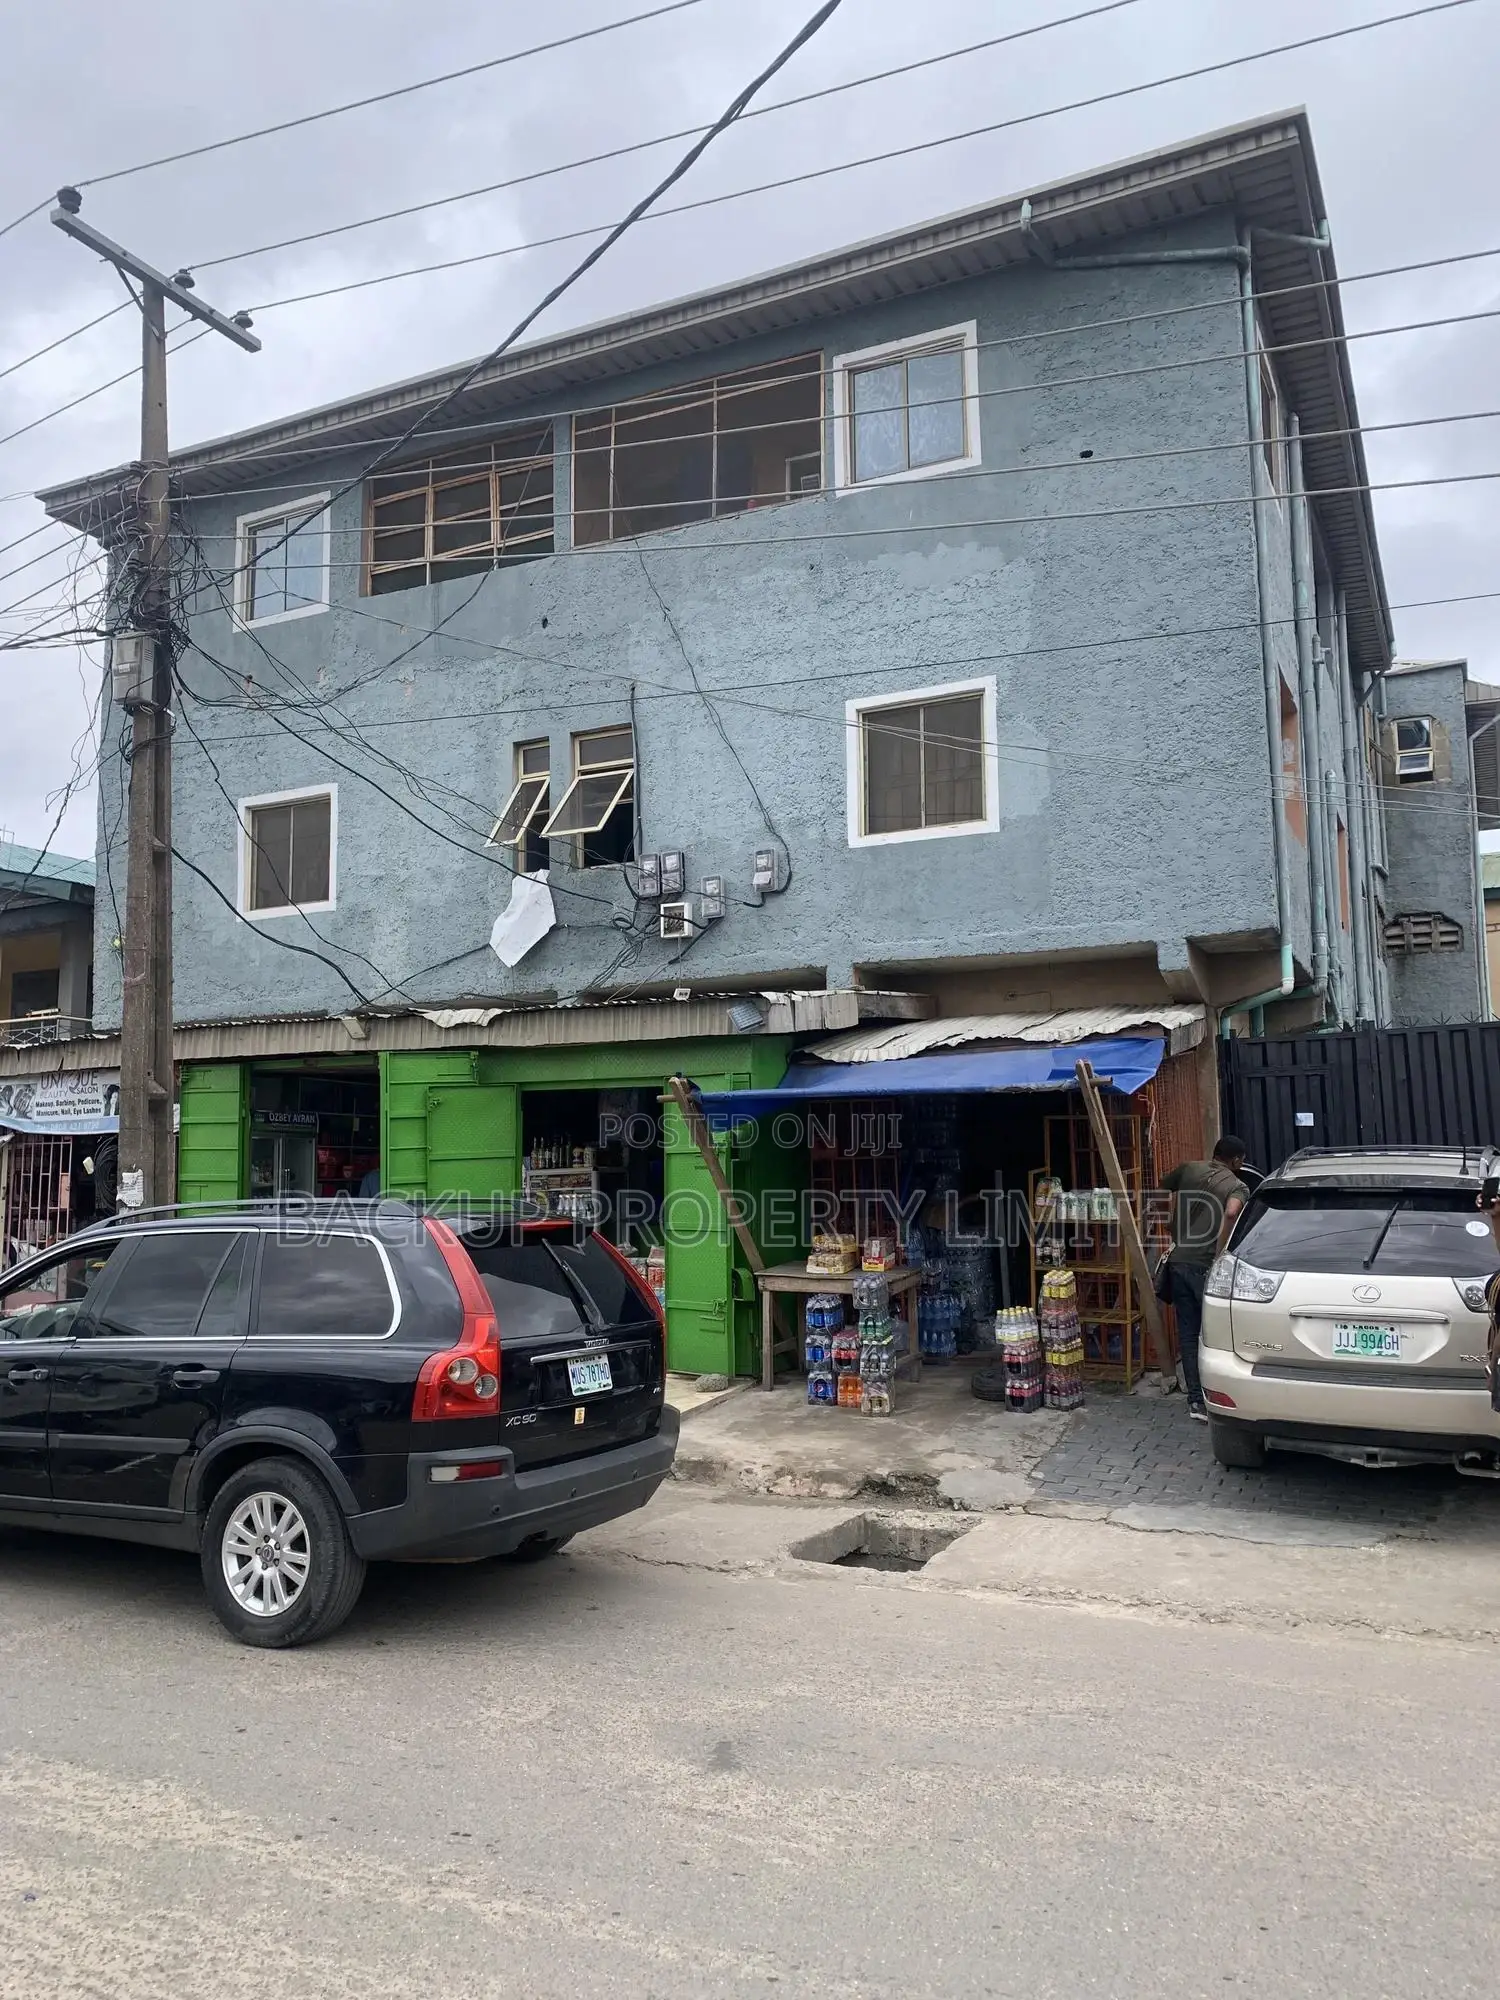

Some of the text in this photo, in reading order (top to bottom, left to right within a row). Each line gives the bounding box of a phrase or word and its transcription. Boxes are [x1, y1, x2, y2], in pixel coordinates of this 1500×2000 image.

[77, 1086, 98, 1095] SALON
[73, 1108, 82, 1117] Eye
[83, 1107, 101, 1115] Lashes
[1241, 1340, 1284, 1351] LEXUS
[505, 1413, 537, 1427] XC90
